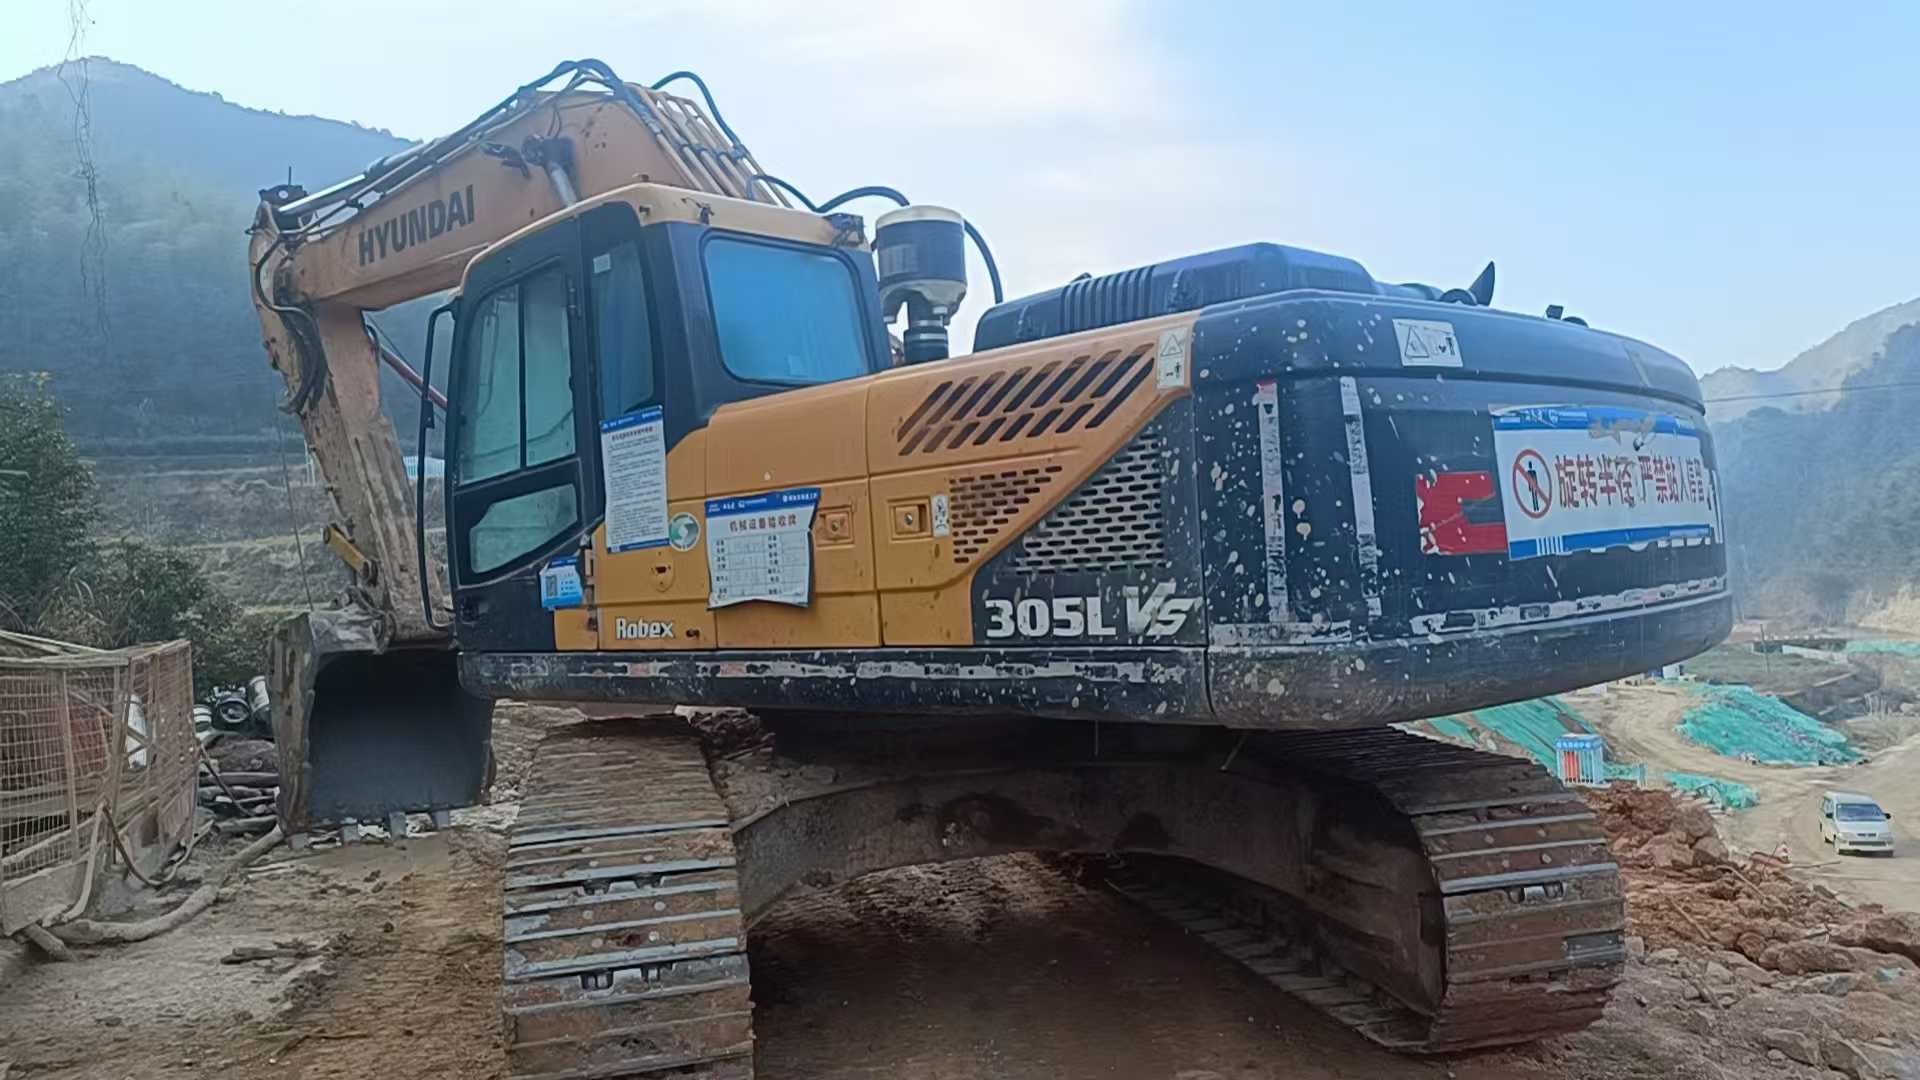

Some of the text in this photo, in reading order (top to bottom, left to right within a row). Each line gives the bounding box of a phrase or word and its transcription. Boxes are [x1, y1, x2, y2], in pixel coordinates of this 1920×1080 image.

[358, 185, 475, 267] HYUNDAI
[615, 618, 675, 640] Robex
[984, 596, 1117, 639] 305L
